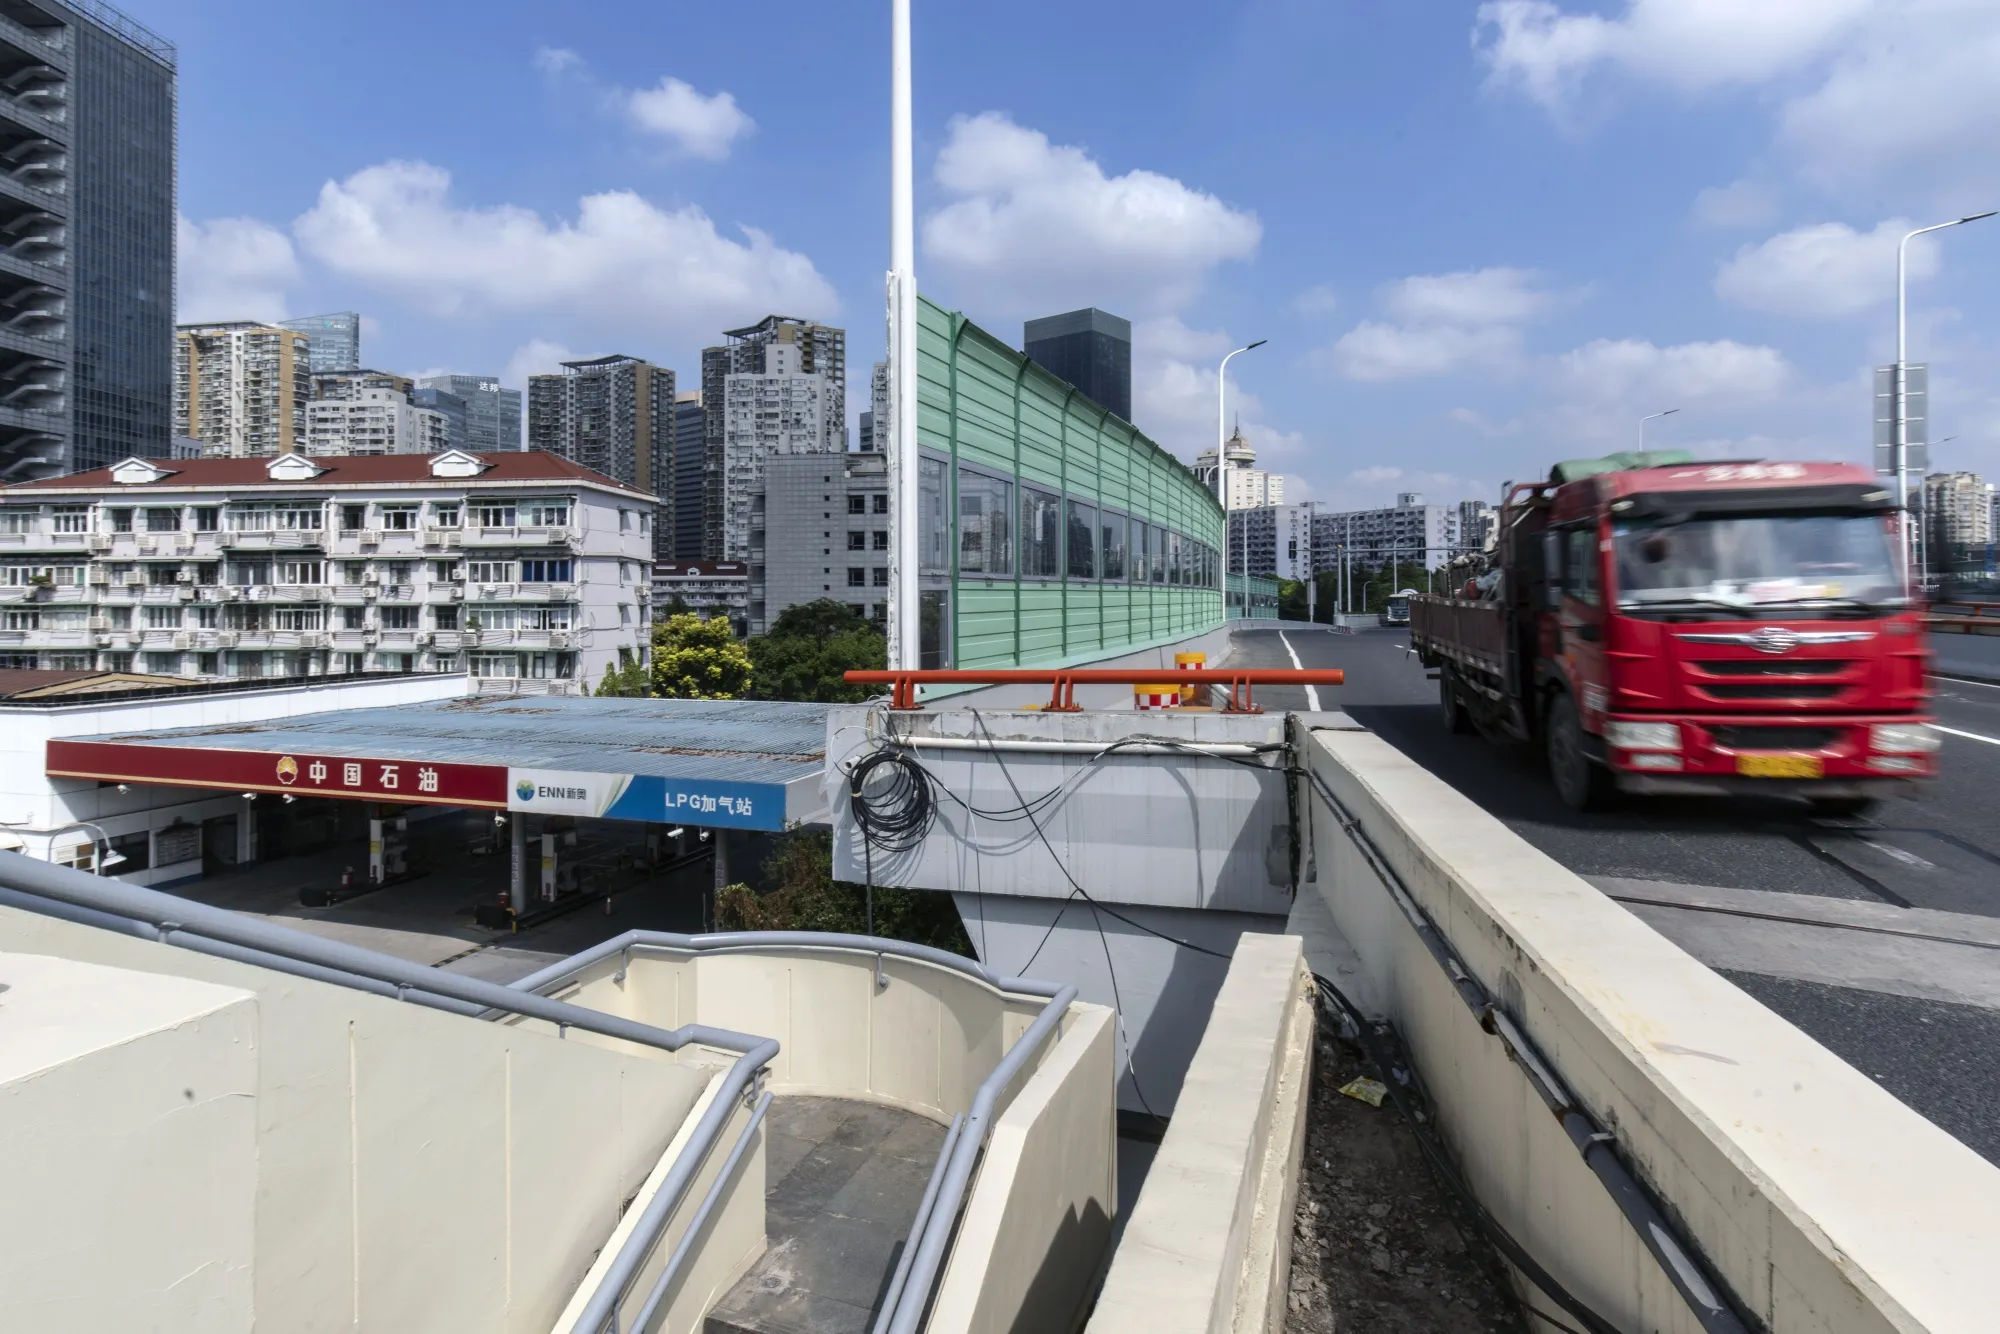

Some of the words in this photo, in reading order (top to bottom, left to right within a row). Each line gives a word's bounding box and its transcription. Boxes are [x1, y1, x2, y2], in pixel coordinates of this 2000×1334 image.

[479, 381, 499, 393] 达邦
[309, 760, 439, 792] 中国石油
[665, 792, 753, 816] LPG加气站
